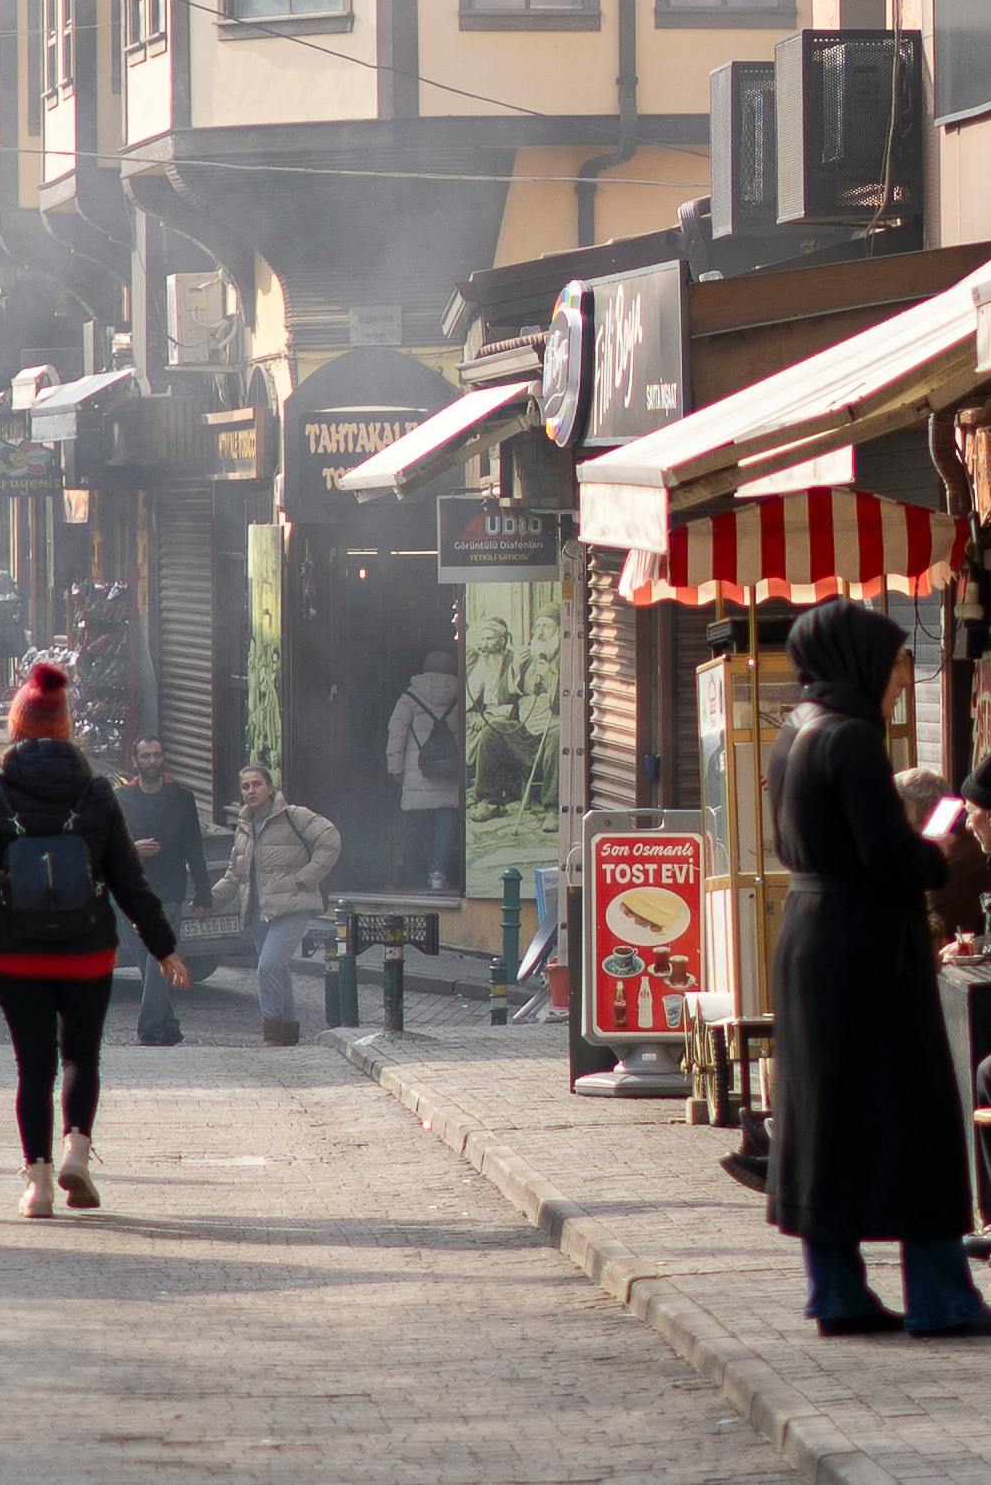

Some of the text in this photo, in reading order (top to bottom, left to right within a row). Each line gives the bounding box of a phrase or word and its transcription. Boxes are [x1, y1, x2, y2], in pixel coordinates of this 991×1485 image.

[600, 841, 695, 857] Son Osmanlı
[601, 857, 695, 885] TOST EVİ
